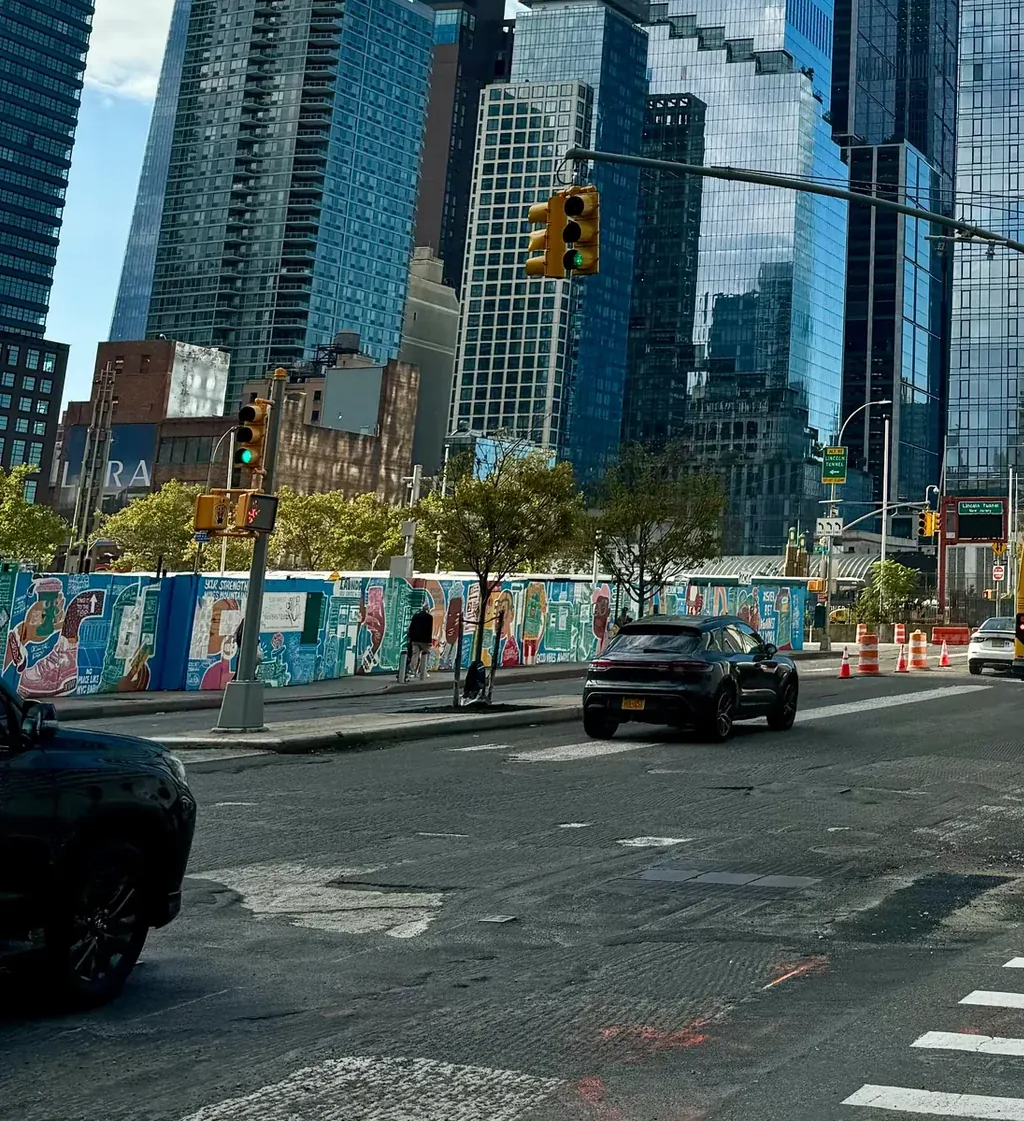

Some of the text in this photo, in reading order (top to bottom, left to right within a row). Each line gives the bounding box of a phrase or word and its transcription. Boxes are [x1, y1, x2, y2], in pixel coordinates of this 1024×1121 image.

[61, 459, 151, 488] LRA
[203, 579, 249, 591] YOUR STRENGTH
